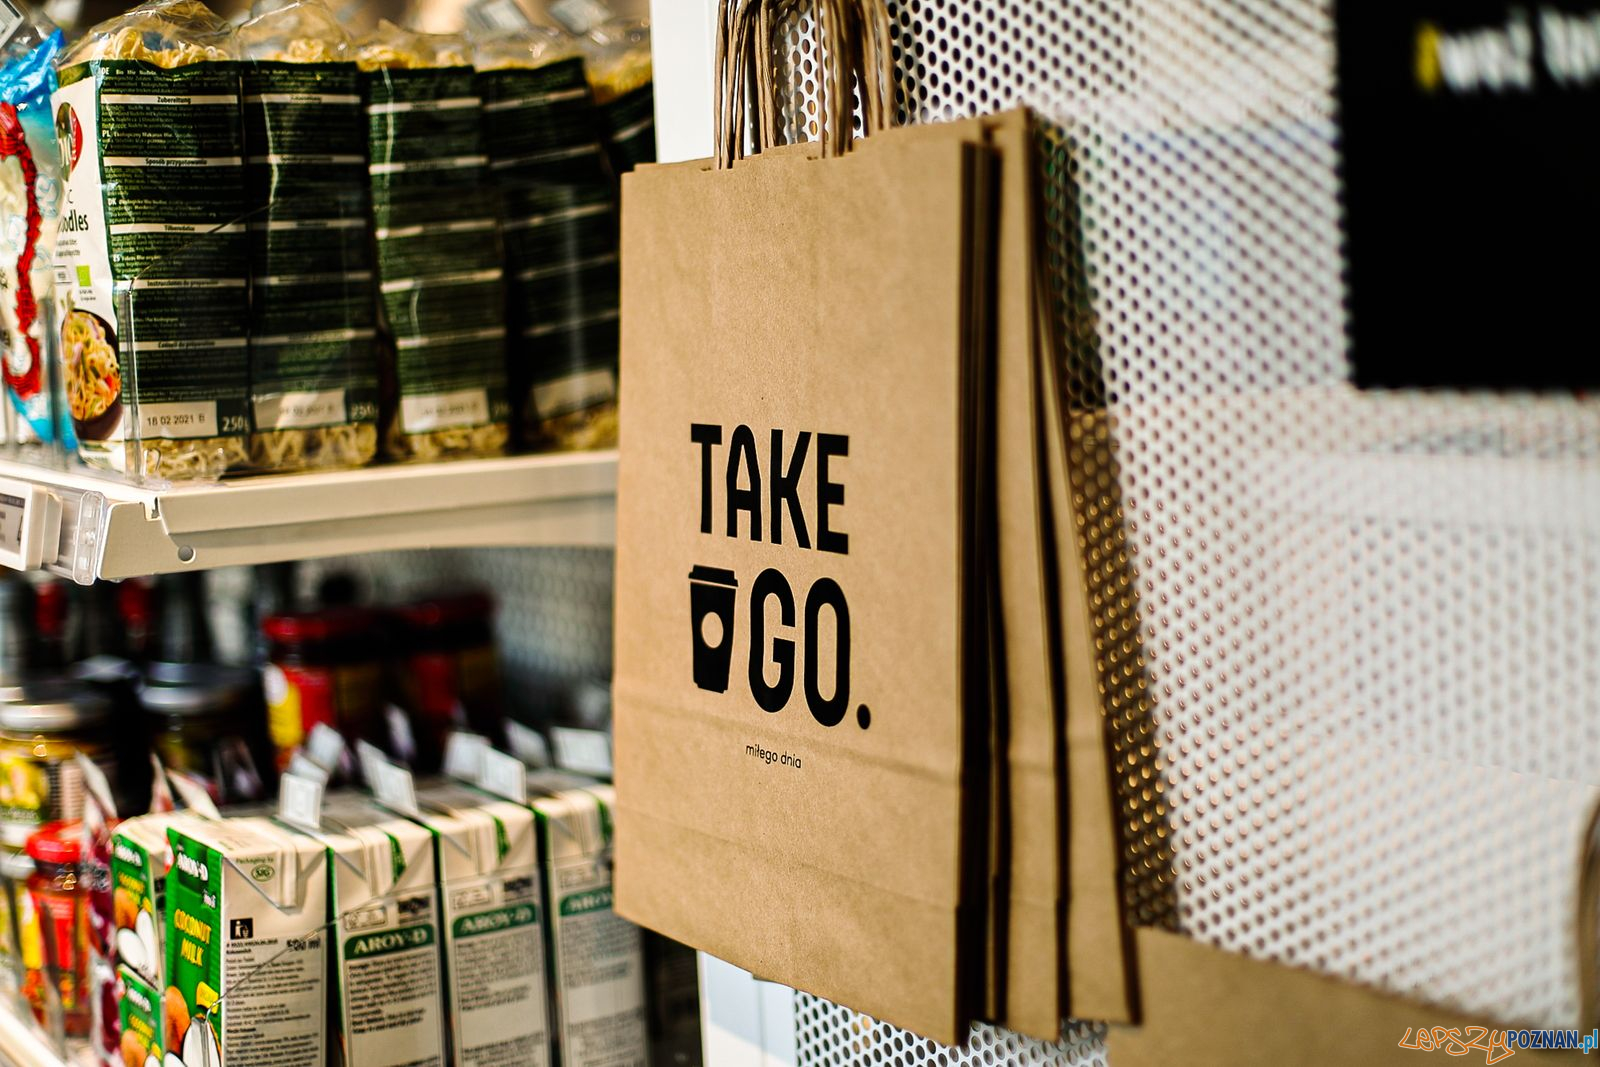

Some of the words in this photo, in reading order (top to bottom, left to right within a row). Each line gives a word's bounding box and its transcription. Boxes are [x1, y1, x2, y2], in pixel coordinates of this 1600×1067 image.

[157, 96, 191, 104] Zubereitung
[57, 209, 89, 233] oodles
[160, 415, 172, 426] 02
[174, 414, 194, 426] 2021
[690, 423, 849, 555] TAKE
[748, 568, 871, 730] GO.
[745, 744, 778, 765] miłego
[780, 750, 802, 769] dnia
[174, 908, 212, 945] COCONUT
[181, 937, 204, 967] MILK
[353, 928, 428, 955] AROY-D
